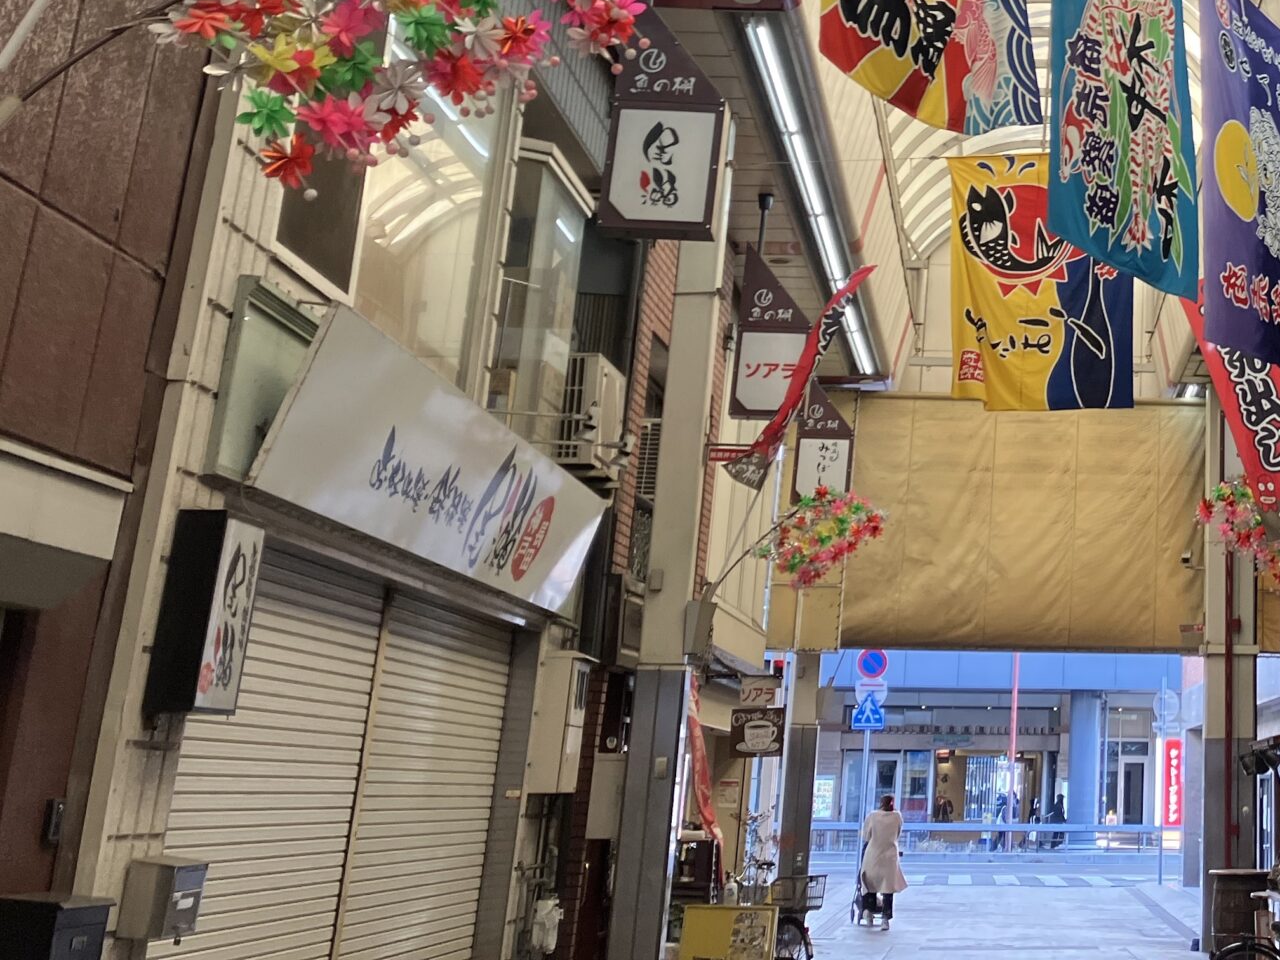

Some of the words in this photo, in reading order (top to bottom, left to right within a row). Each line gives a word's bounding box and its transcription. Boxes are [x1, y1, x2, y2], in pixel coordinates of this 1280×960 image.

[629, 74, 696, 95] 魚の棚
[748, 307, 793, 322] 魚の棚
[745, 362, 800, 379] ソアラ
[804, 419, 839, 430] 魚の棚
[741, 687, 776, 703] ソアラ
